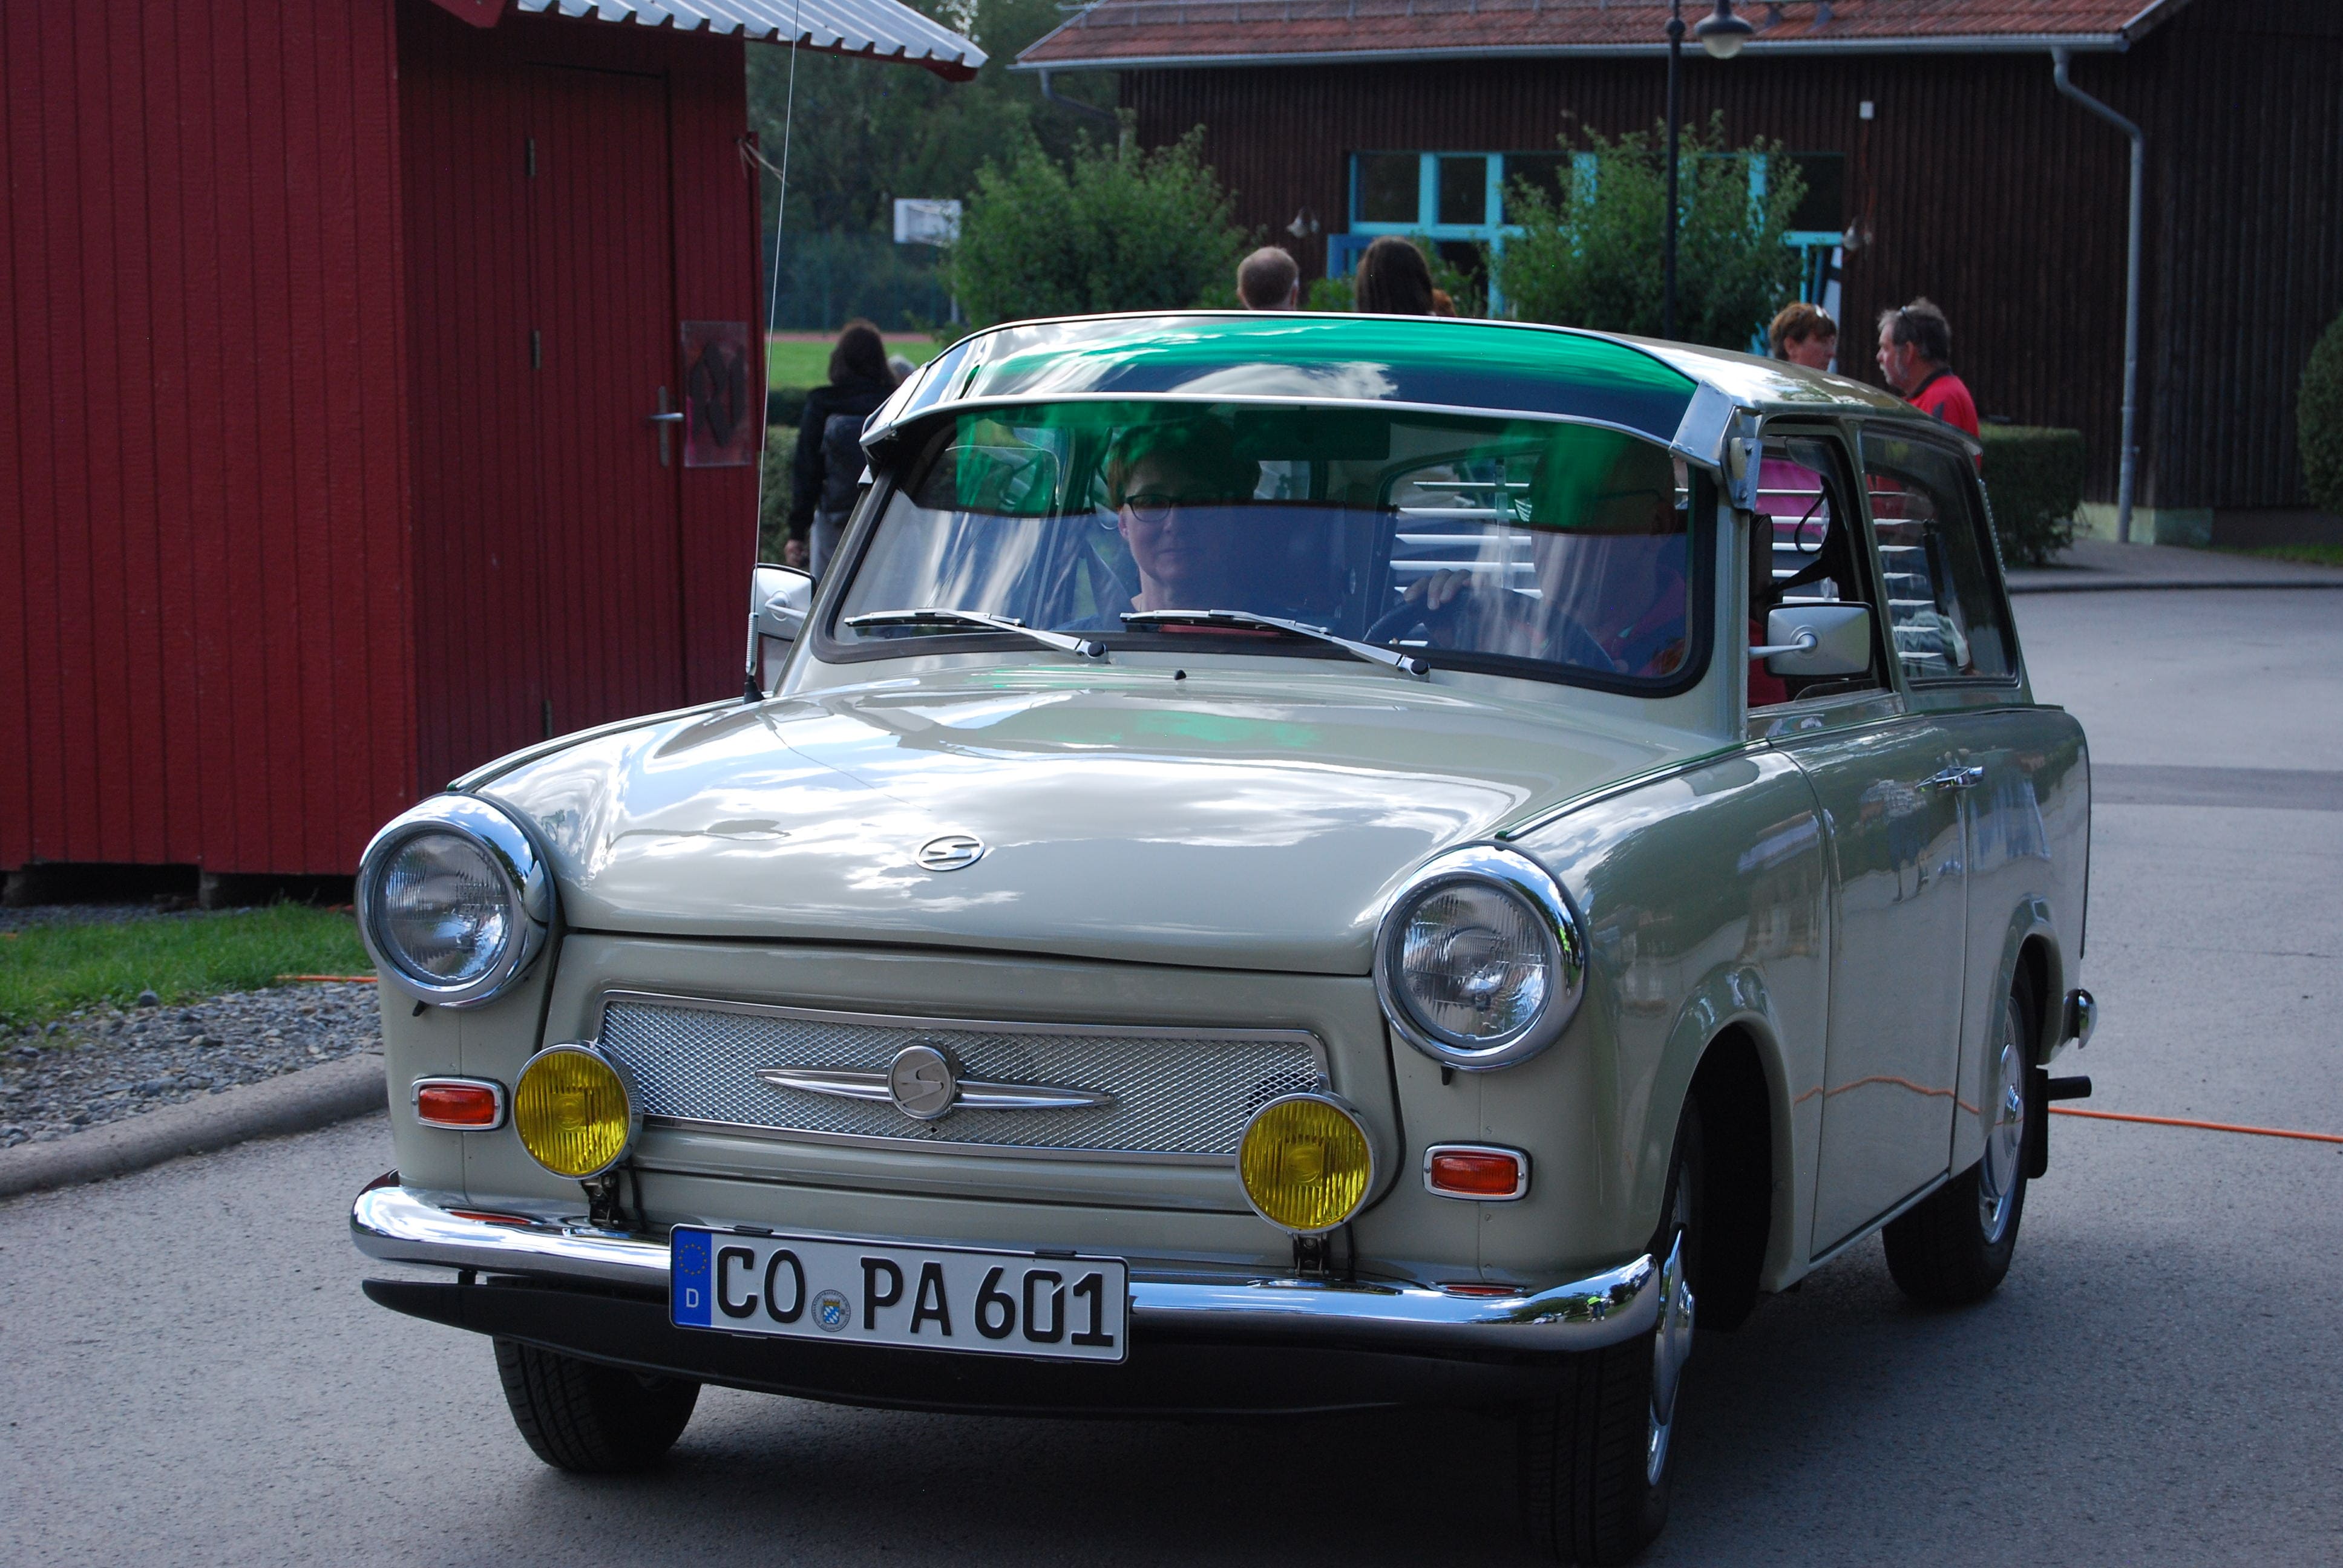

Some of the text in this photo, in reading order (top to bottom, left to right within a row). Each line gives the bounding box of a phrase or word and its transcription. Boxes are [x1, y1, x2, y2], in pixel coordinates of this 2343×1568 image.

[686, 1287, 700, 1308] D
[717, 1246, 807, 1324] CO
[860, 1256, 952, 1336] PA
[974, 1266, 1114, 1347] 601
